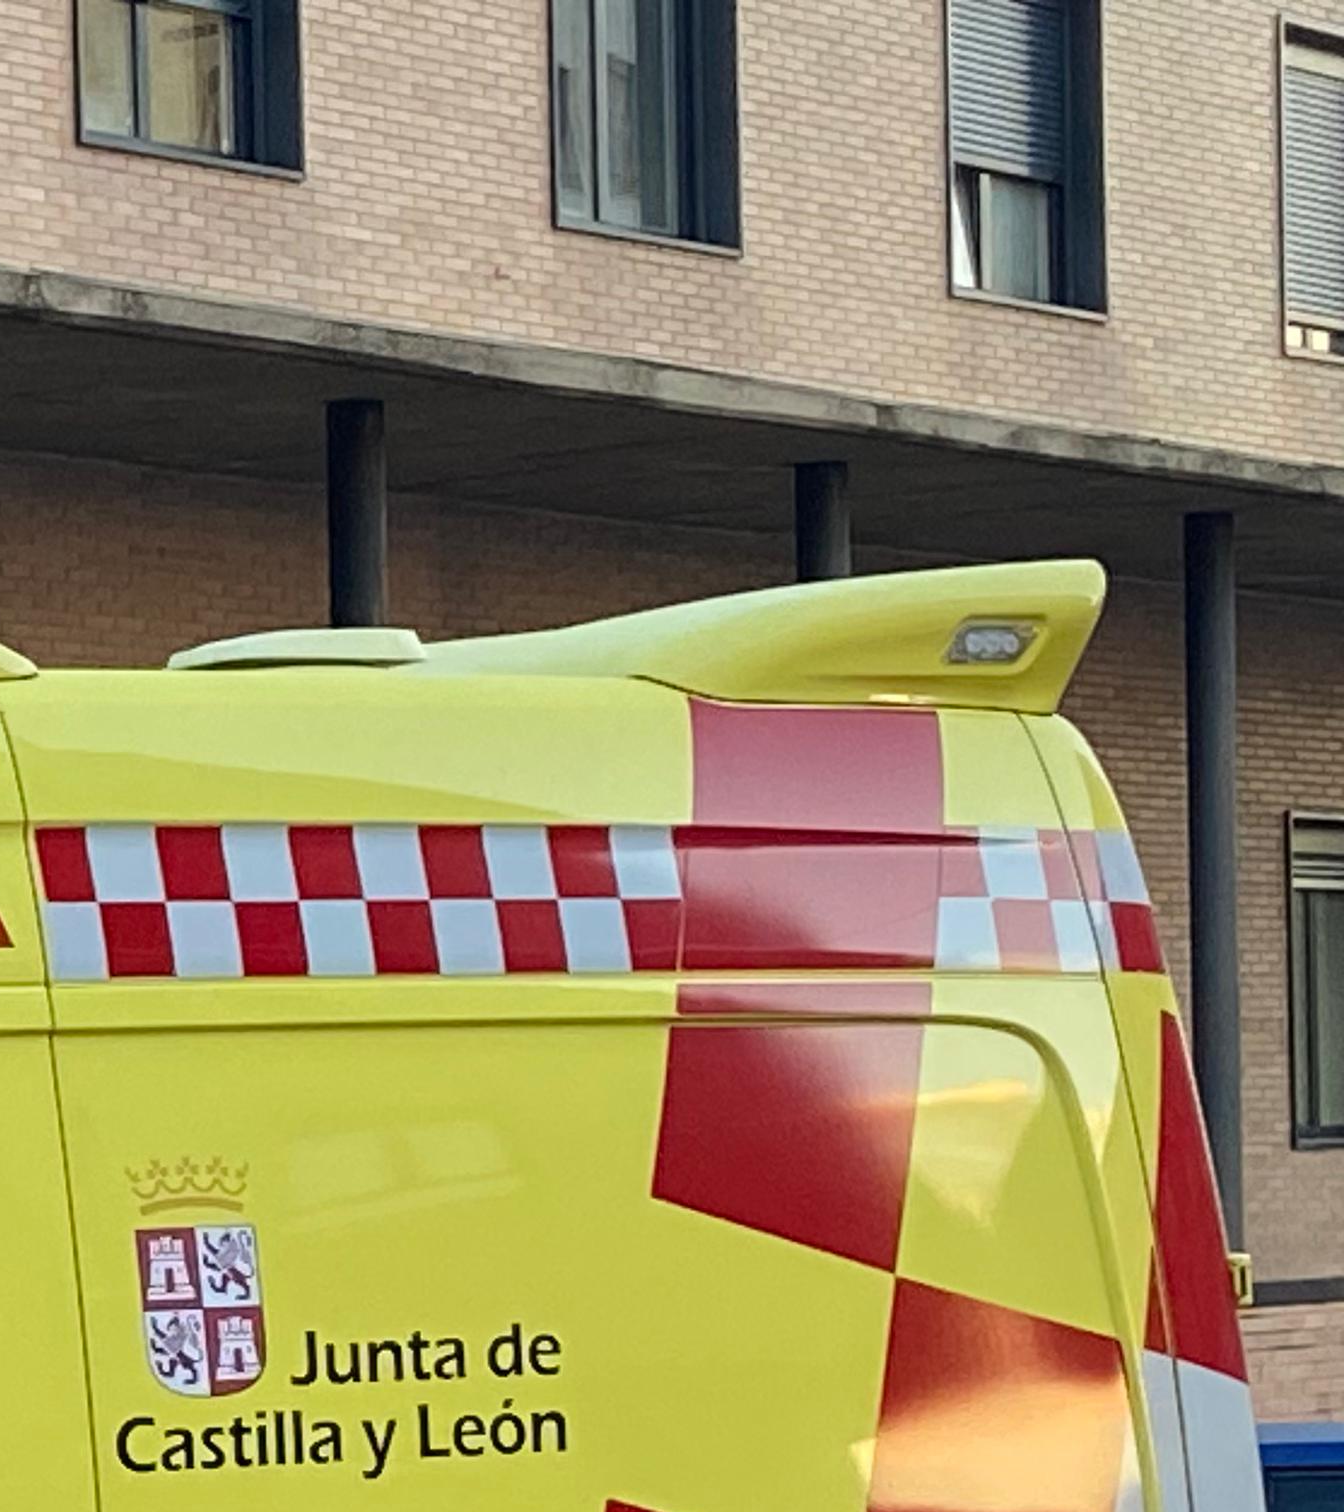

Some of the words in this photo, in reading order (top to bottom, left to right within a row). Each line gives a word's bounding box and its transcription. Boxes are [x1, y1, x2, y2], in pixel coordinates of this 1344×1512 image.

[290, 1330, 466, 1385] Junta
[487, 1323, 561, 1377] de
[116, 1410, 343, 1473] Castilla
[362, 1417, 397, 1479] y
[418, 1398, 567, 1458] León
